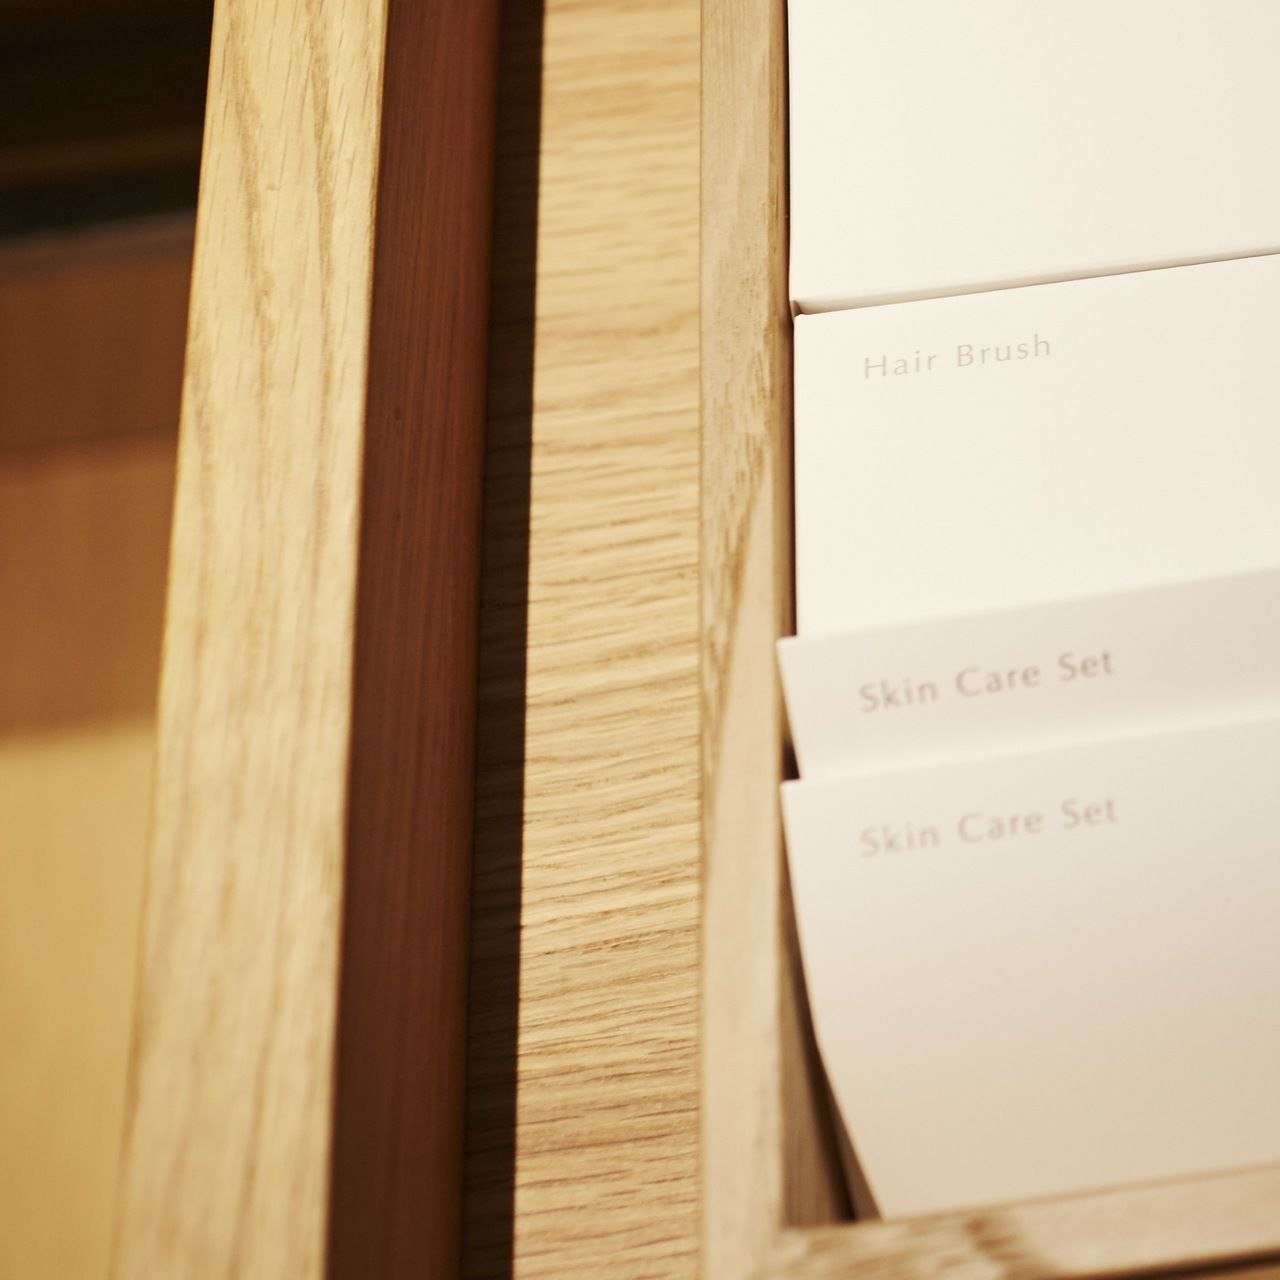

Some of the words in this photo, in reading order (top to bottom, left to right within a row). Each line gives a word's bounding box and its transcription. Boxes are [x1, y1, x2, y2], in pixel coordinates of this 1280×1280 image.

[863, 350, 939, 381] Hair
[956, 332, 1052, 369] Brush
[858, 677, 940, 714] Skin
[954, 666, 1042, 699] Care
[1057, 649, 1117, 683] Set
[859, 821, 942, 860] Skin
[956, 811, 1046, 846] Care
[1060, 796, 1120, 831] Set
